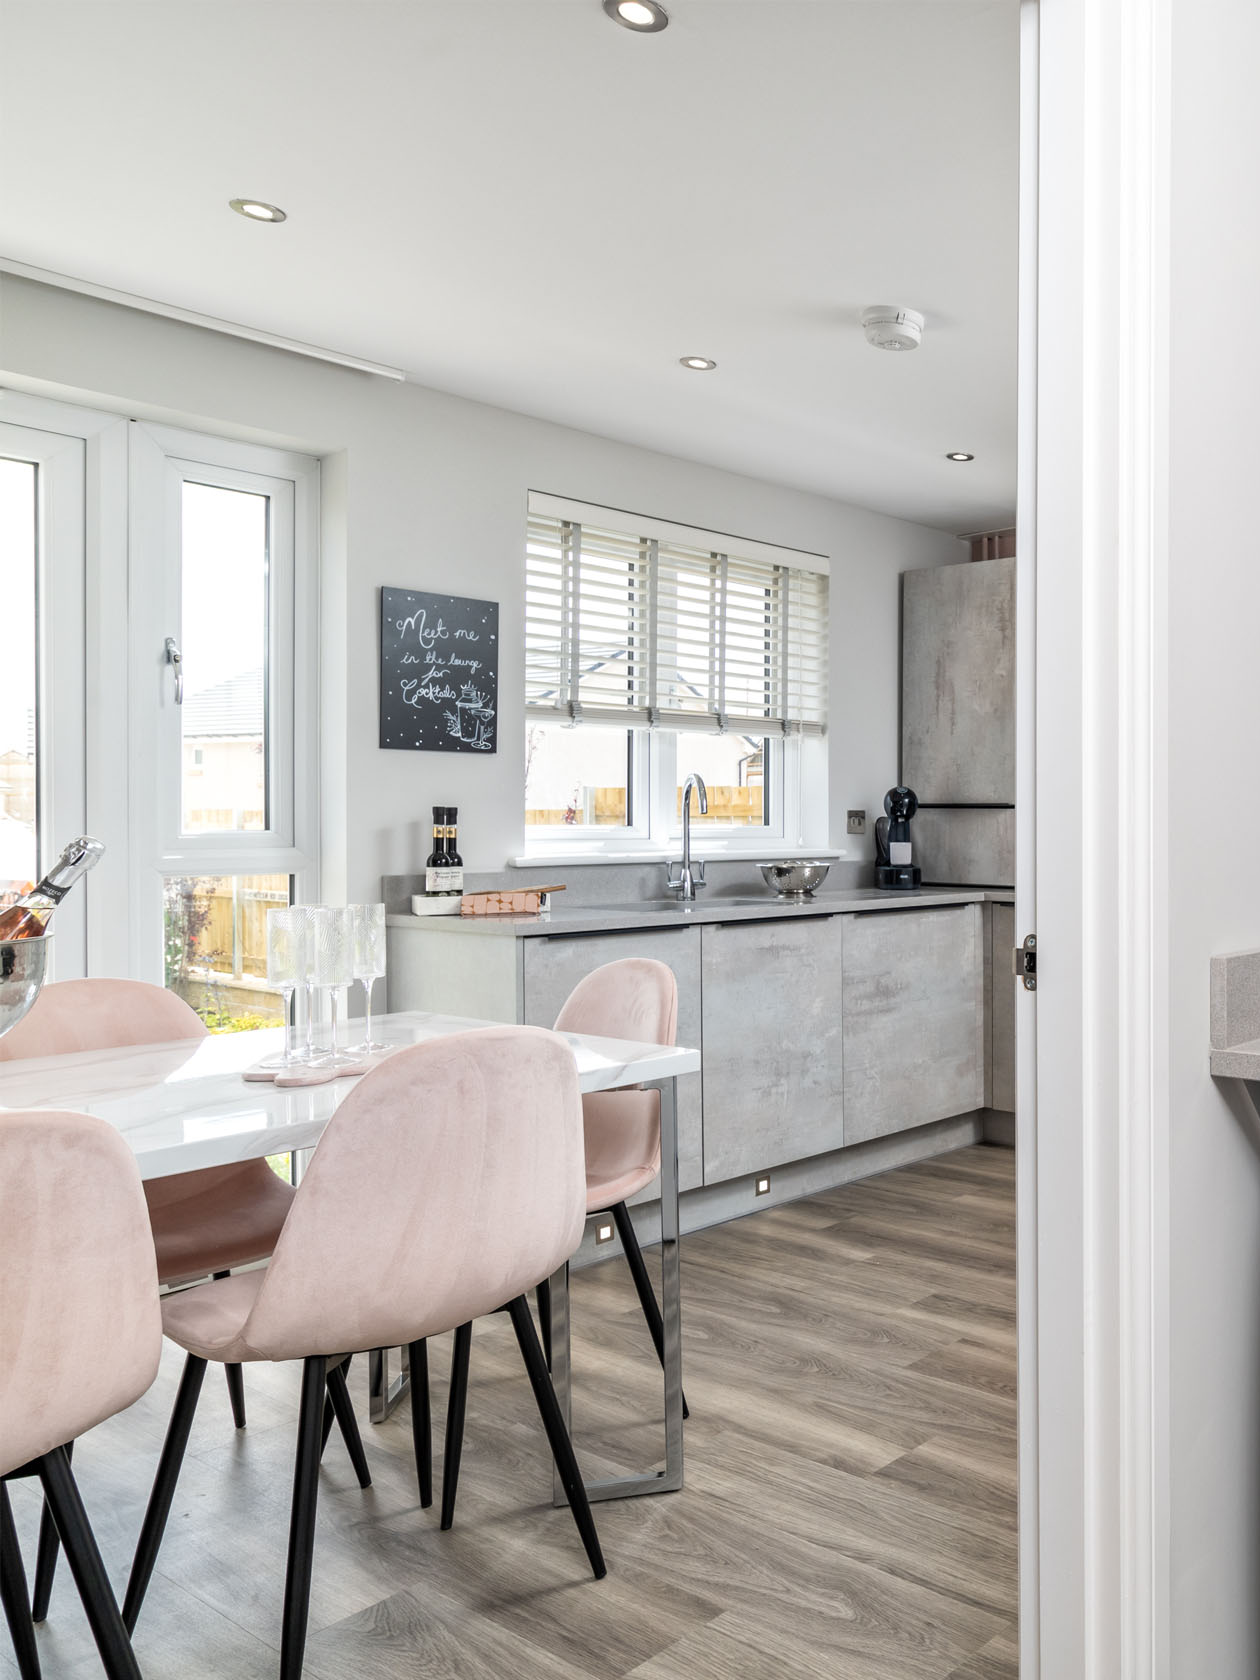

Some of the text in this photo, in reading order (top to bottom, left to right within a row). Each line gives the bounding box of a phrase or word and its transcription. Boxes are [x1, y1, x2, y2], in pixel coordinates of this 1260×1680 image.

[396, 609, 480, 648] Meet me
[400, 651, 482, 675] in the lounge
[421, 665, 451, 686] for
[400, 679, 457, 708] Cocktails
